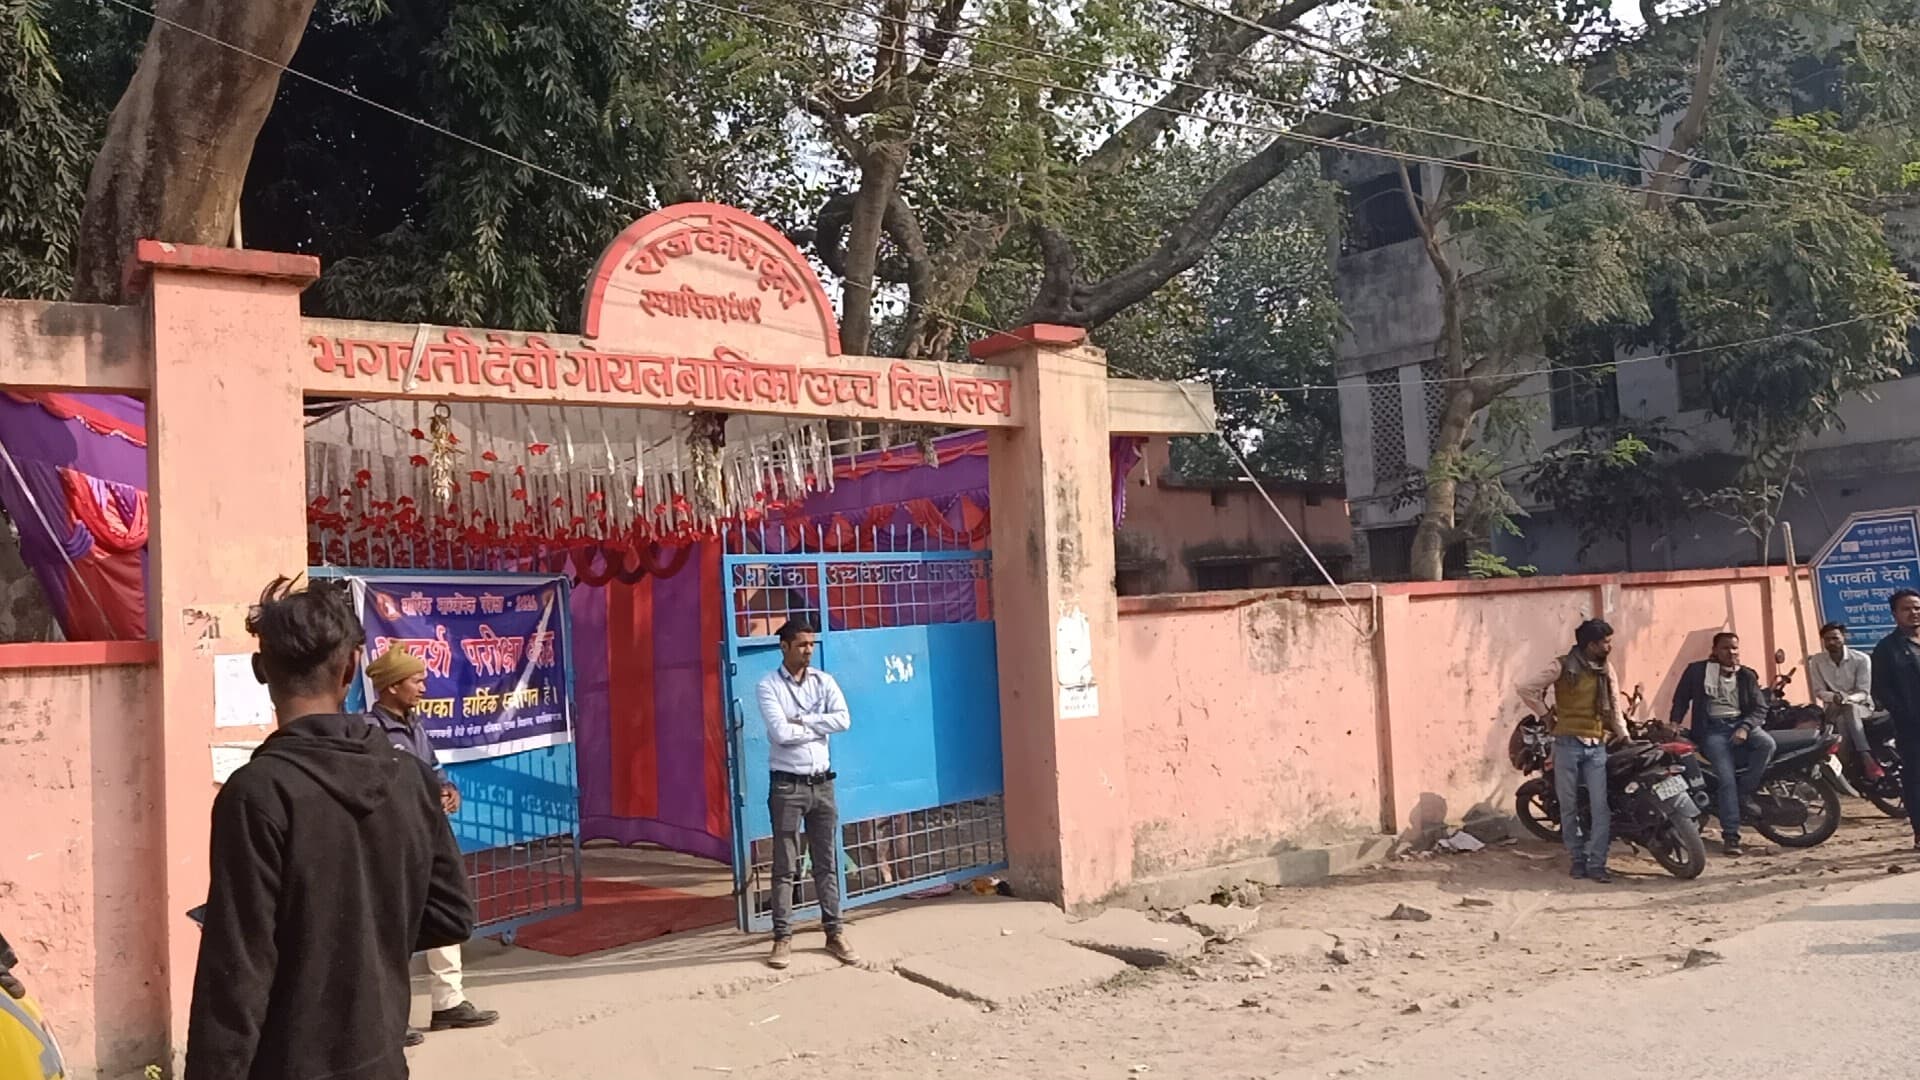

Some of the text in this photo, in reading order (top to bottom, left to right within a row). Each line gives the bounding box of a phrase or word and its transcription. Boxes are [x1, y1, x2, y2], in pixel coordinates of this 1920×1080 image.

[481, 331, 560, 392] देवी
[564, 340, 674, 397] गोयल
[678, 346, 798, 404] बालिका
[800, 367, 881, 409] उच्च
[888, 361, 1012, 417] विद्यालय
[1825, 565, 1911, 585] भगवती देवी
[372, 625, 453, 679] दर्श
[461, 624, 524, 677] परीक्षा
[463, 687, 499, 718] हार्दिक
